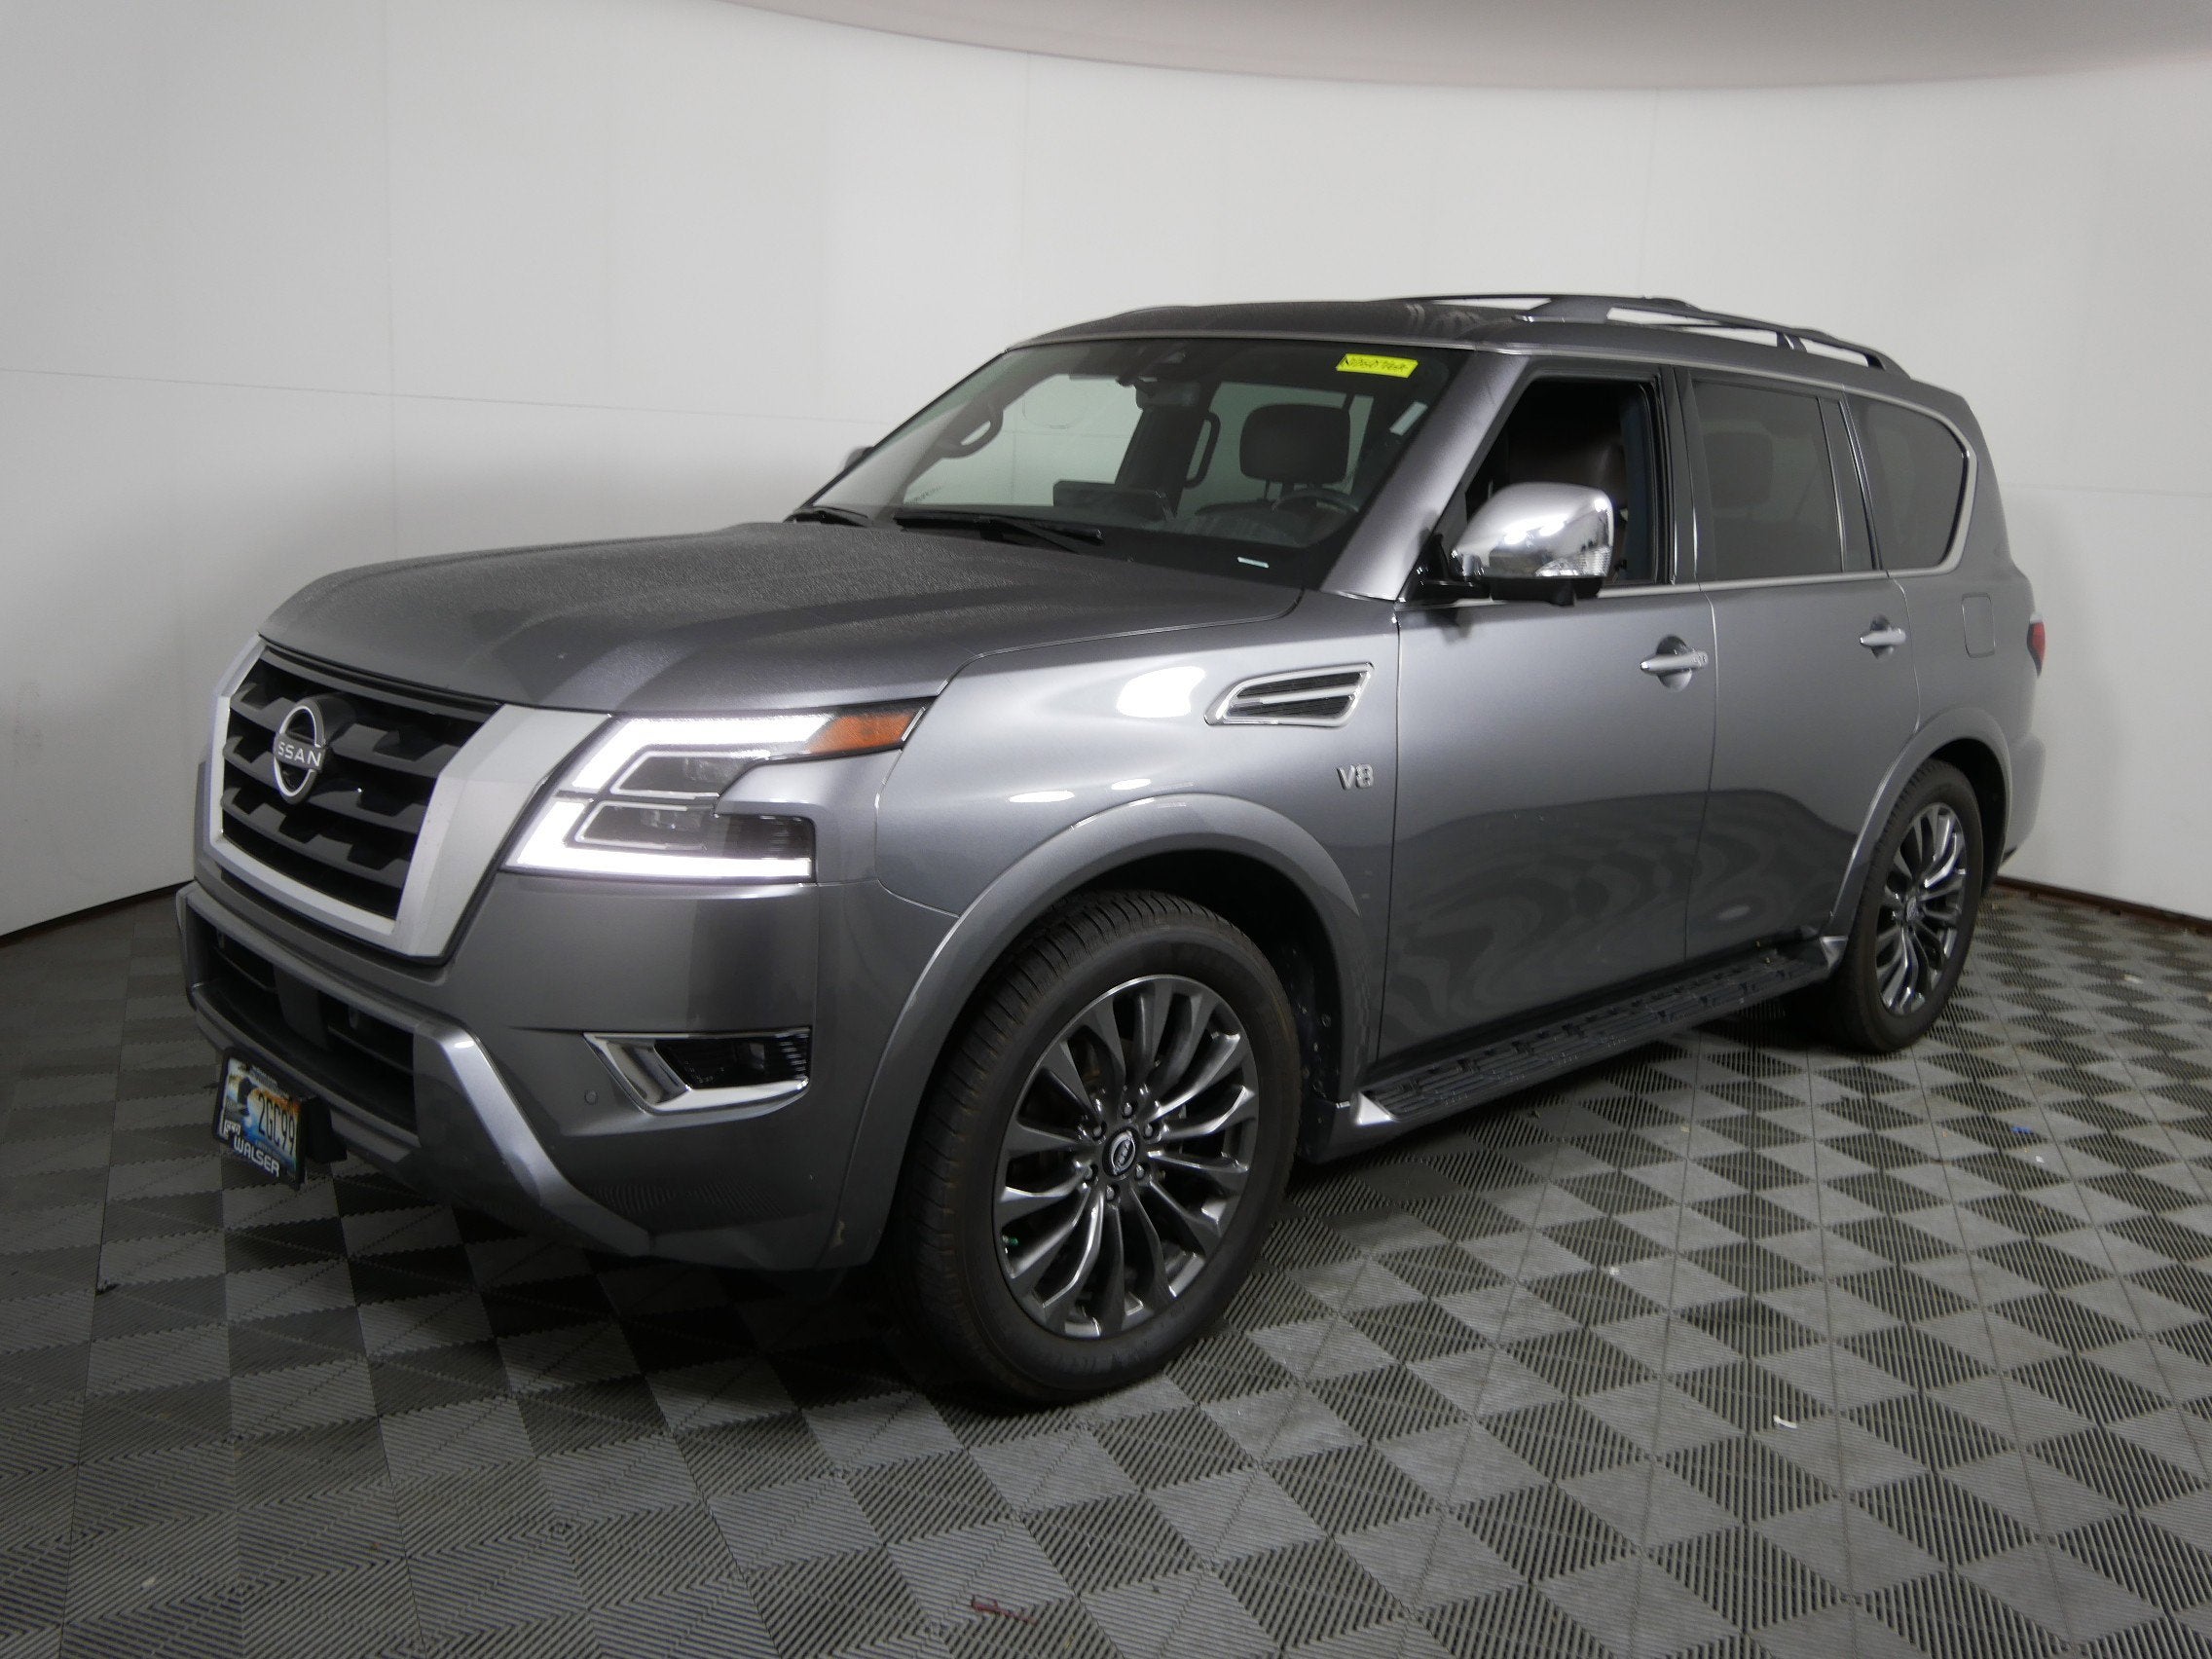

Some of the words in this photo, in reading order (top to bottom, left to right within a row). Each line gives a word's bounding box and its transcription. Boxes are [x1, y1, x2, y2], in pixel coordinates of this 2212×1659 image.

[277, 741, 321, 767] SSAN
[1337, 764, 1374, 790] V8
[234, 1136, 279, 1177] WALSER
